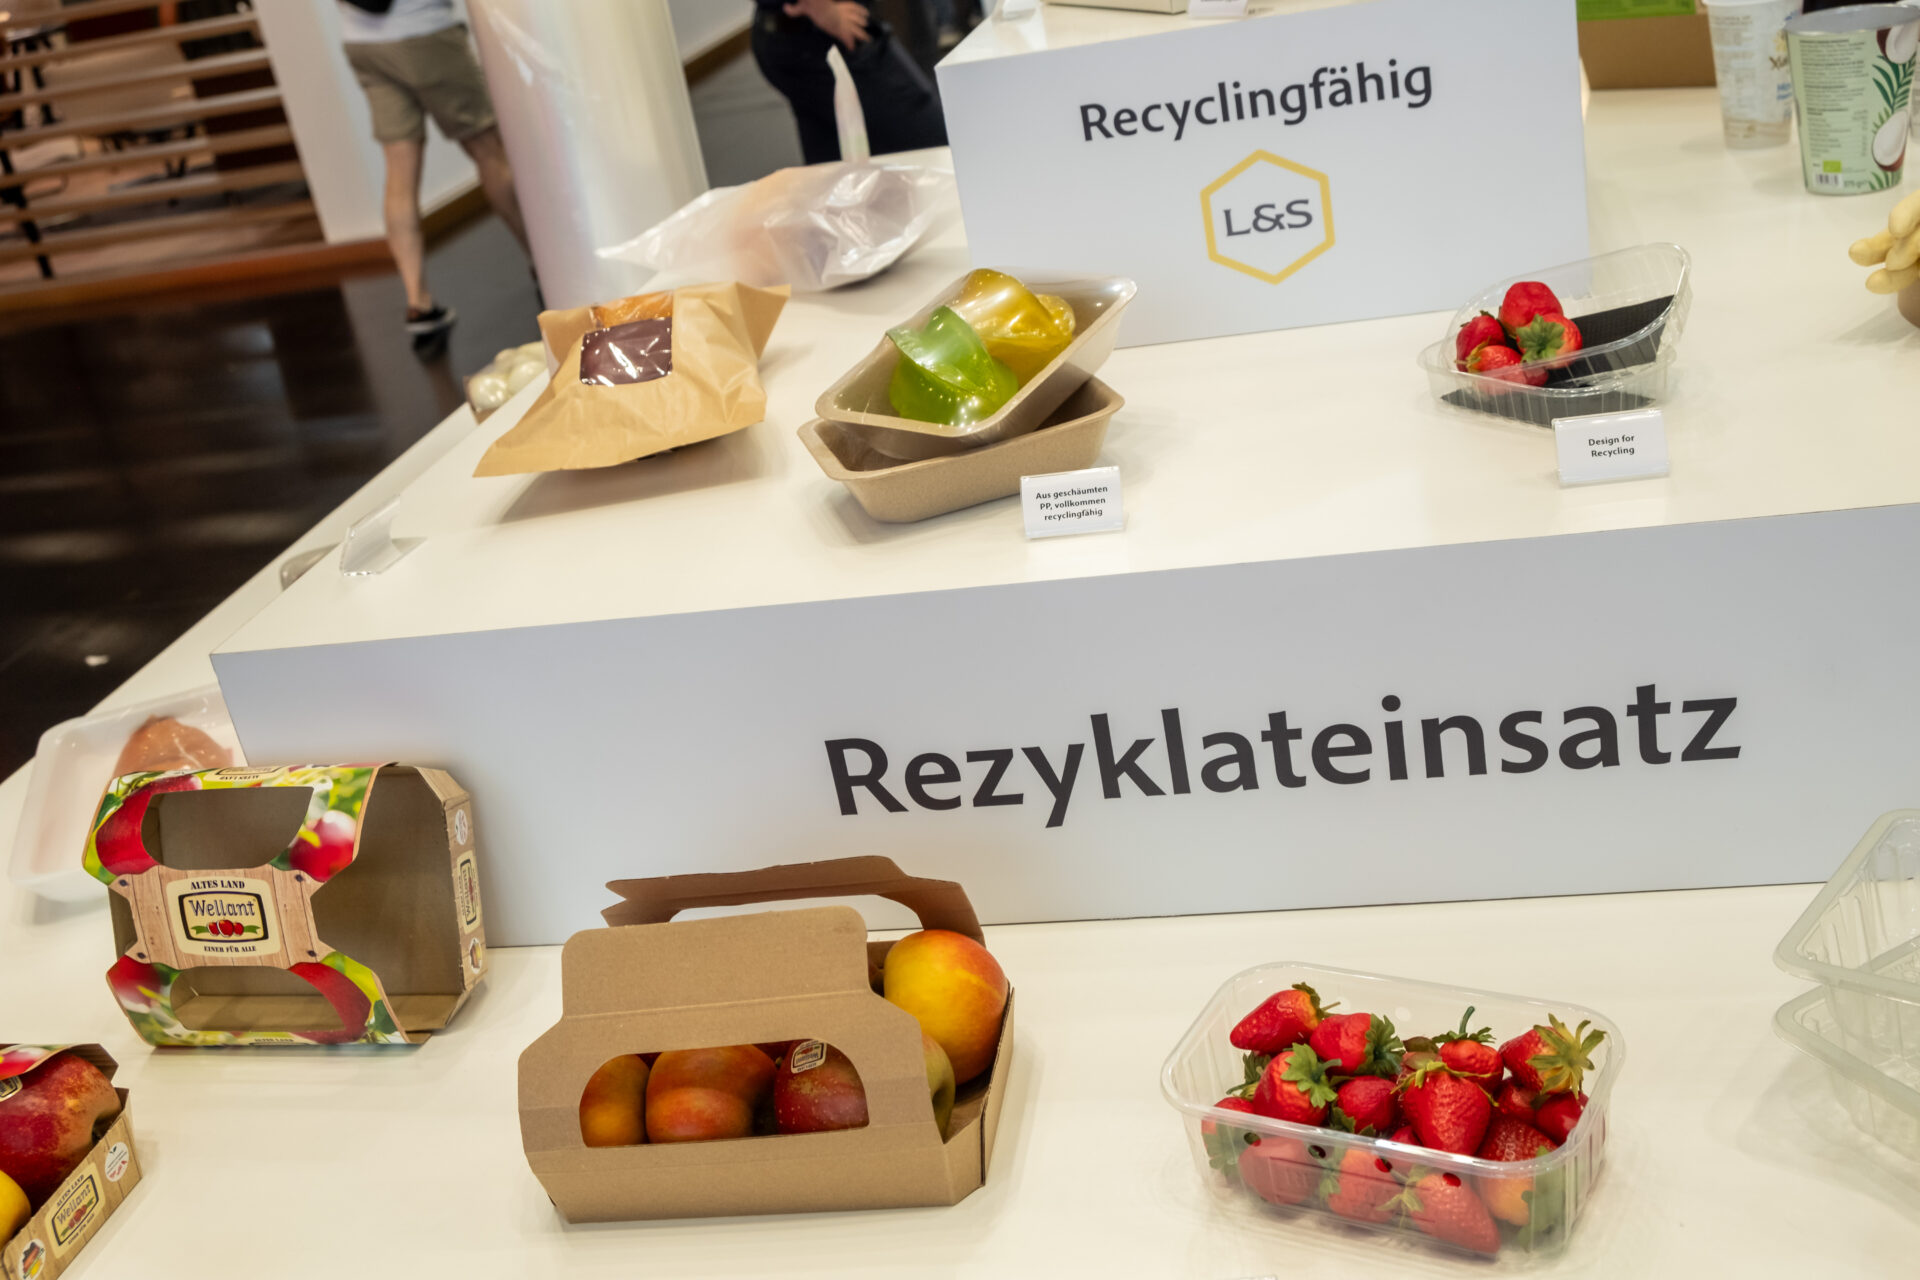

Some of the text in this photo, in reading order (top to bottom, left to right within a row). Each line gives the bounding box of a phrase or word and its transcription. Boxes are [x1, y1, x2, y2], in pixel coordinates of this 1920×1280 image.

[1080, 58, 1432, 142] Recyclingfähig
[1223, 199, 1313, 236] L&S
[1588, 434, 1635, 447] Design for
[1591, 446, 1635, 458] Recycling
[1036, 486, 1108, 500] Aus geschäumten
[1040, 498, 1106, 511] PP, vollkommen
[1044, 508, 1103, 521] recyclingfähig
[824, 683, 1742, 829] Rezyklateinsatz
[191, 880, 245, 890] ALTES LAND
[188, 899, 255, 917] Wellant
[204, 945, 256, 953] EINER FÜR ALLE
